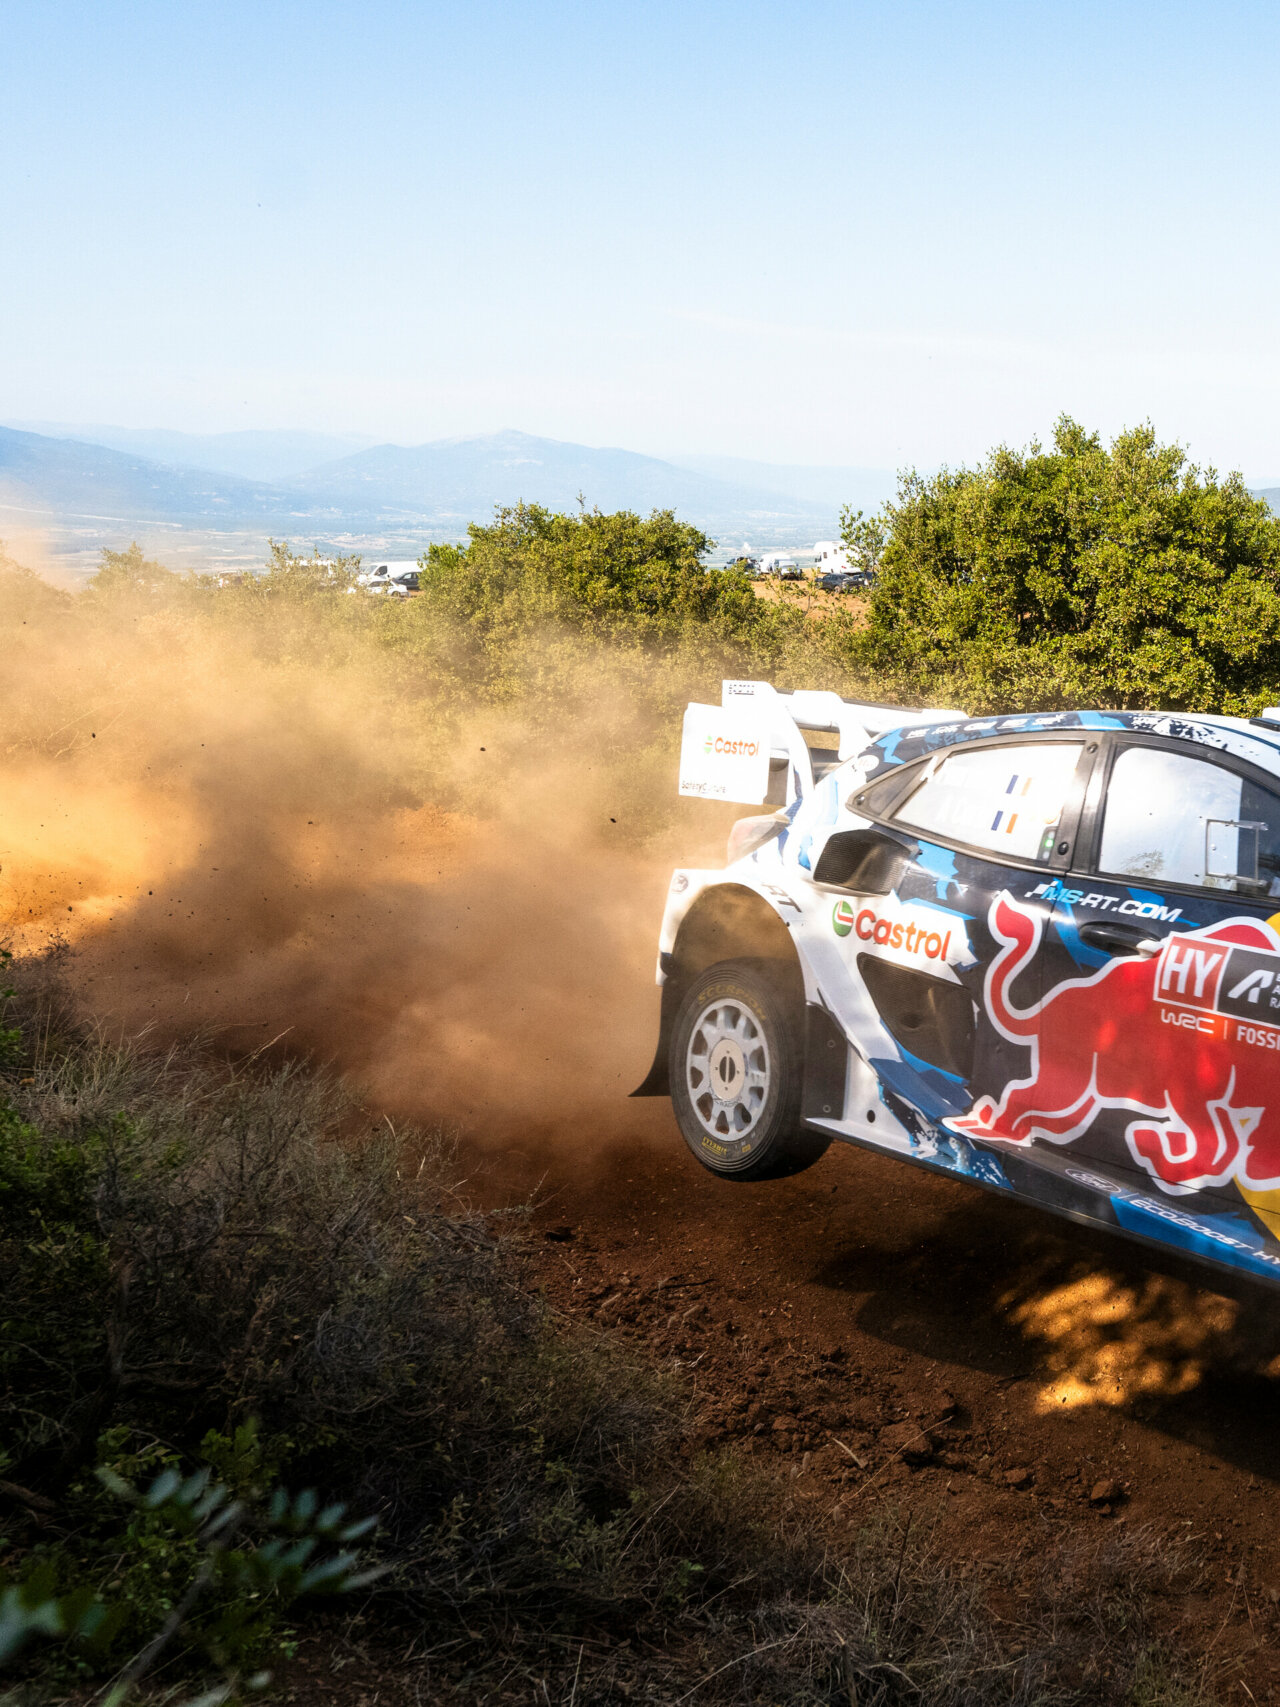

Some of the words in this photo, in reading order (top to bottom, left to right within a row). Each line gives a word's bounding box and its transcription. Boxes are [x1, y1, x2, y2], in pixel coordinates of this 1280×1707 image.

[714, 737, 760, 757] Castrol
[855, 909, 952, 961] Castrol
[1161, 945, 1223, 998] HY
[1160, 1009, 1215, 1034] WRC
[1129, 1199, 1255, 1250] ECOBOOST
